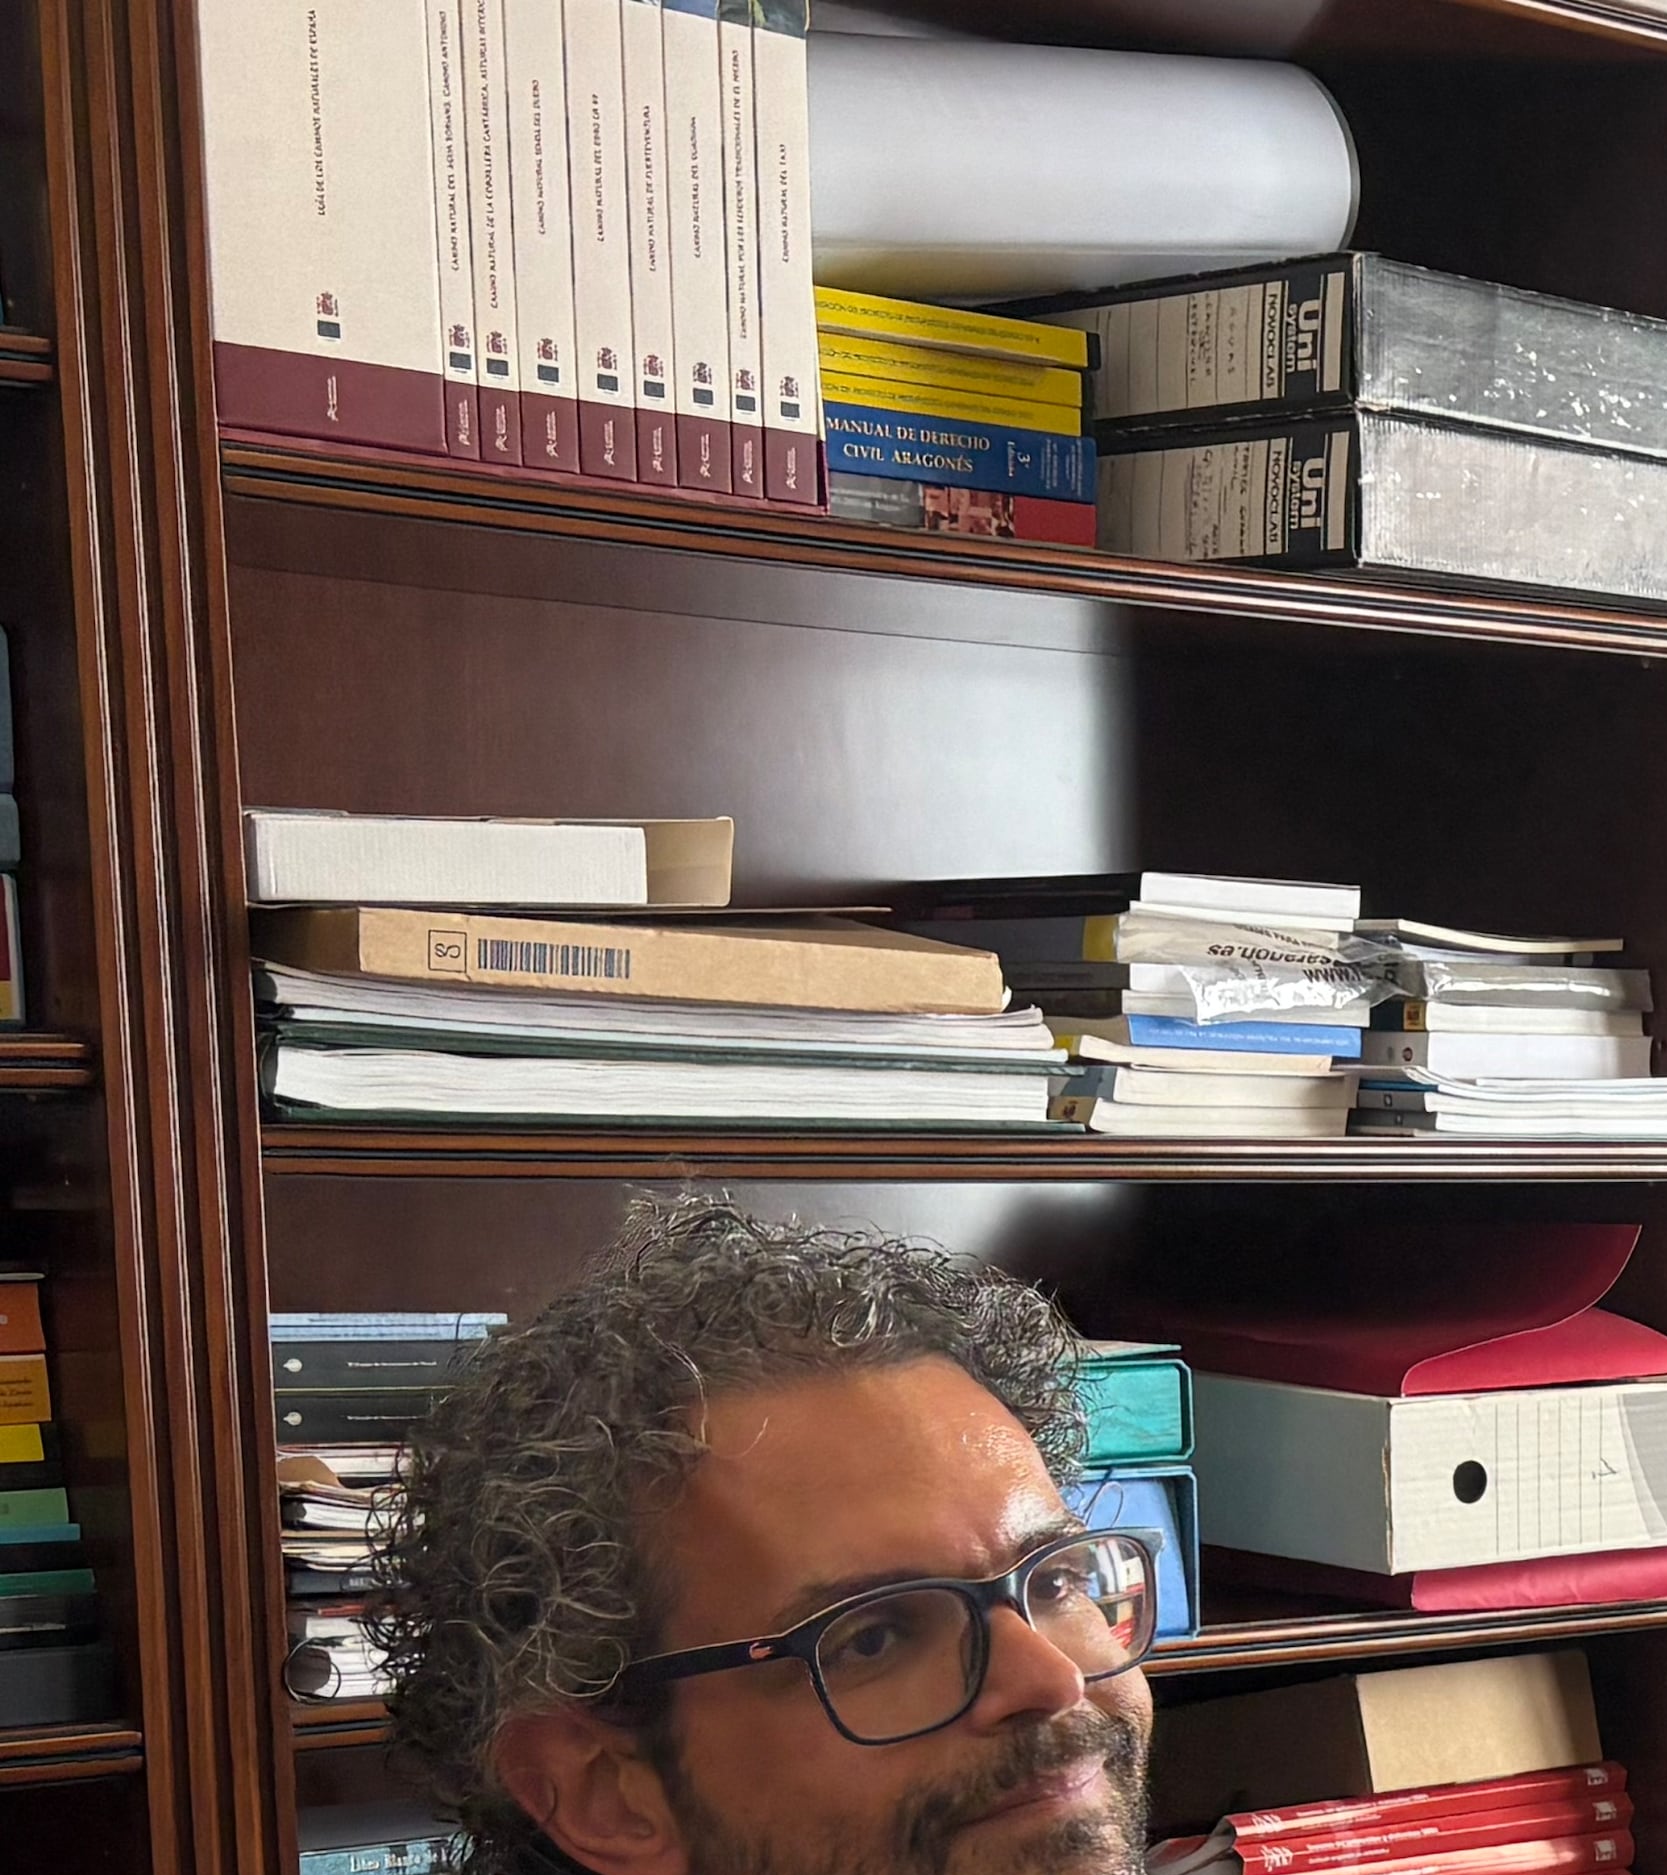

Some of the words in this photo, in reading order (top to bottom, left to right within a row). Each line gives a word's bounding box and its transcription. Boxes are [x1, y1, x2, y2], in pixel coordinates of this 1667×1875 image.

[1265, 293, 1279, 389] NOVOCLAB
[1286, 304, 1298, 373] system
[1297, 299, 1321, 370] Uni
[825, 417, 893, 438] MANUAL
[896, 426, 916, 441] DE
[920, 430, 990, 450] DERECHO
[842, 443, 885, 461] CIVIL
[891, 449, 973, 471] ARAGONÉS
[1269, 451, 1281, 542] NOVOCLAB
[1289, 460, 1301, 530] system
[1300, 457, 1325, 529] Uni
